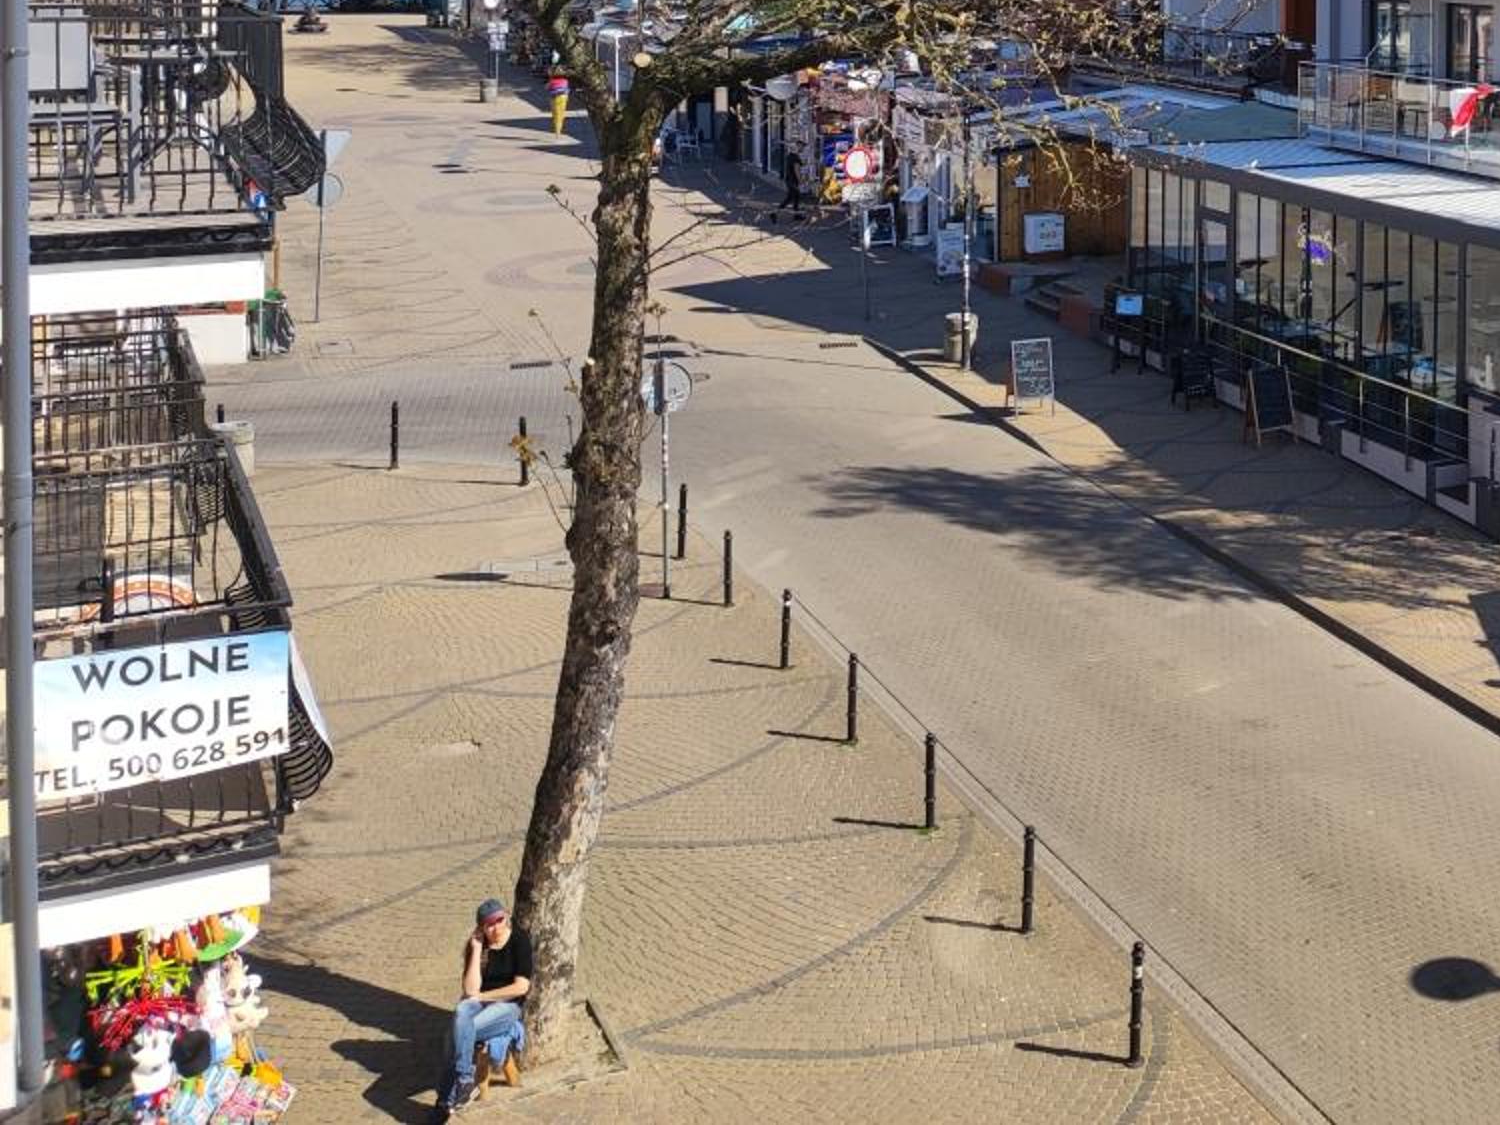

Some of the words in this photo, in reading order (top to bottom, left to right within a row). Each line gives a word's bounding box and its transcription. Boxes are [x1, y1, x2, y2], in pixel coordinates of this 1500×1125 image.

[72, 642, 249, 693] WOLNE
[72, 695, 251, 752] POKOJE
[34, 764, 96, 793] TEL.
[109, 753, 162, 781] 500
[173, 741, 225, 771] 628
[236, 727, 285, 756] 591
